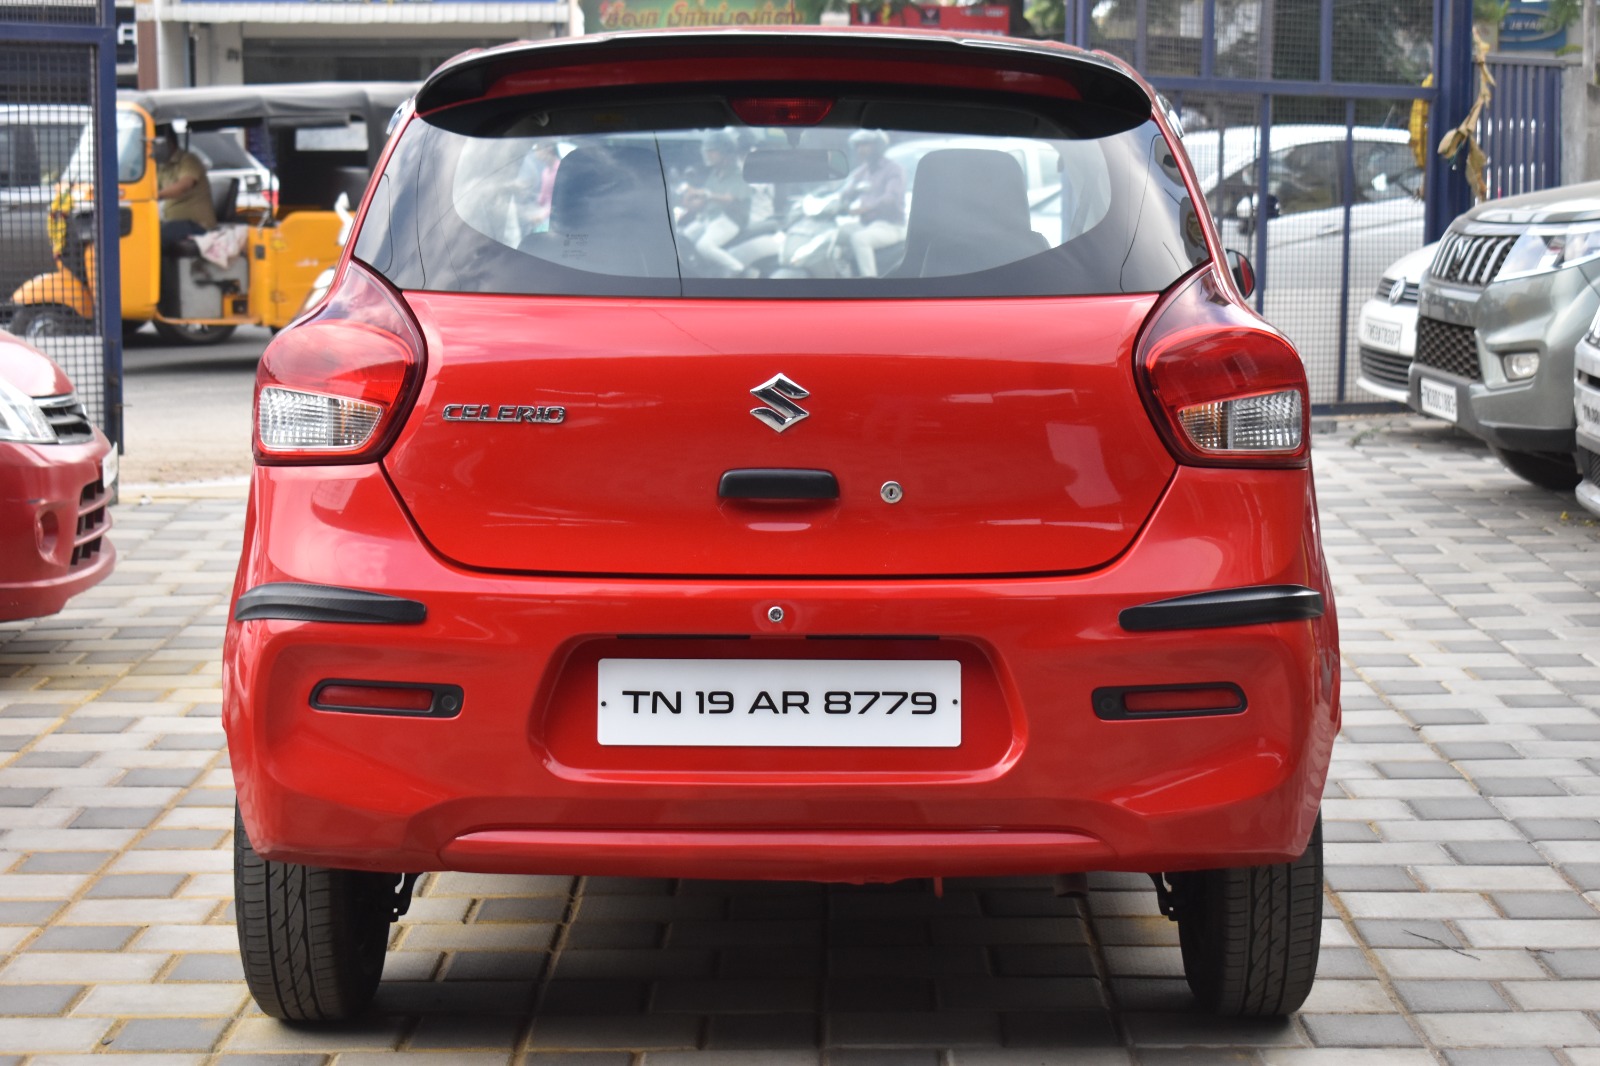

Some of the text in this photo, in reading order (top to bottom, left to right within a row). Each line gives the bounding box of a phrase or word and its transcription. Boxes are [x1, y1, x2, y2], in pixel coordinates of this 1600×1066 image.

[442, 404, 566, 424] CELERIO
[622, 691, 937, 714] TN 19 AR 8779
